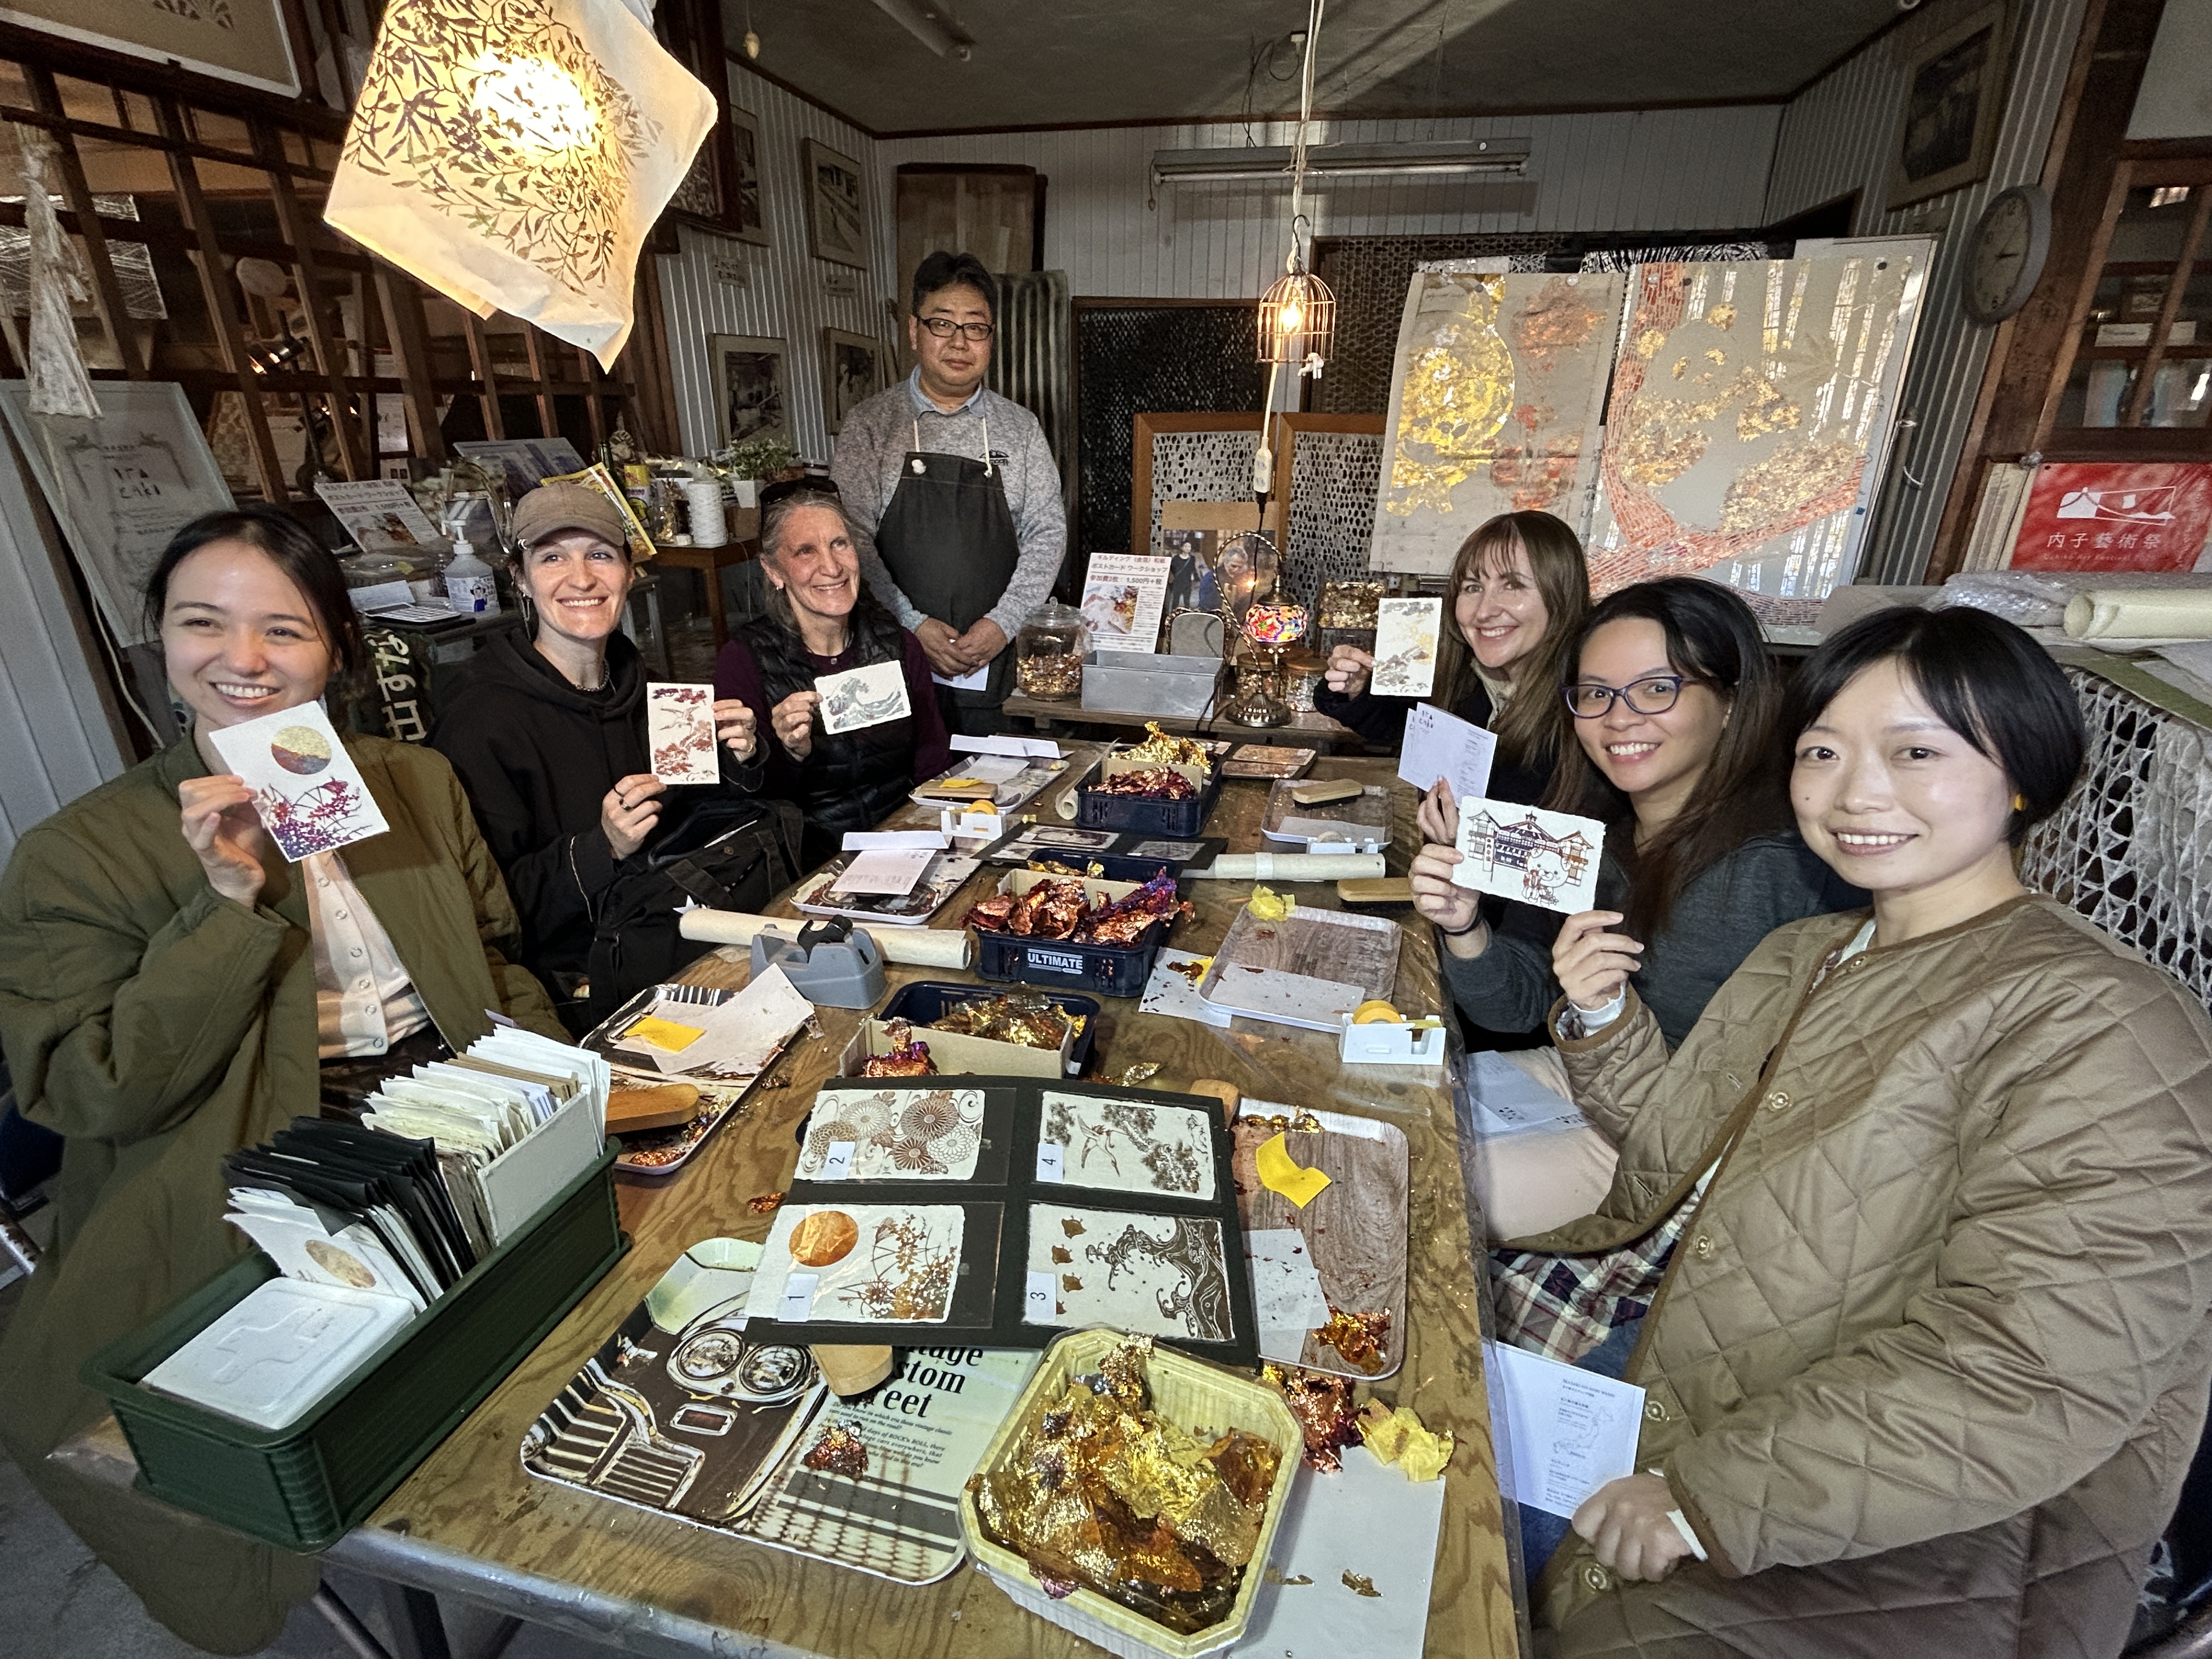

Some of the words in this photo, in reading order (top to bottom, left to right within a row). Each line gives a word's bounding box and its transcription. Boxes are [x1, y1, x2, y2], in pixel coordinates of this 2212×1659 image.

[2047, 532, 2162, 549] 内子藝術祭
[1028, 952, 1083, 969] ULTIMATE
[829, 1156, 846, 1165] 2
[1041, 1157, 1057, 1166] 4
[1030, 1291, 1046, 1301] 3
